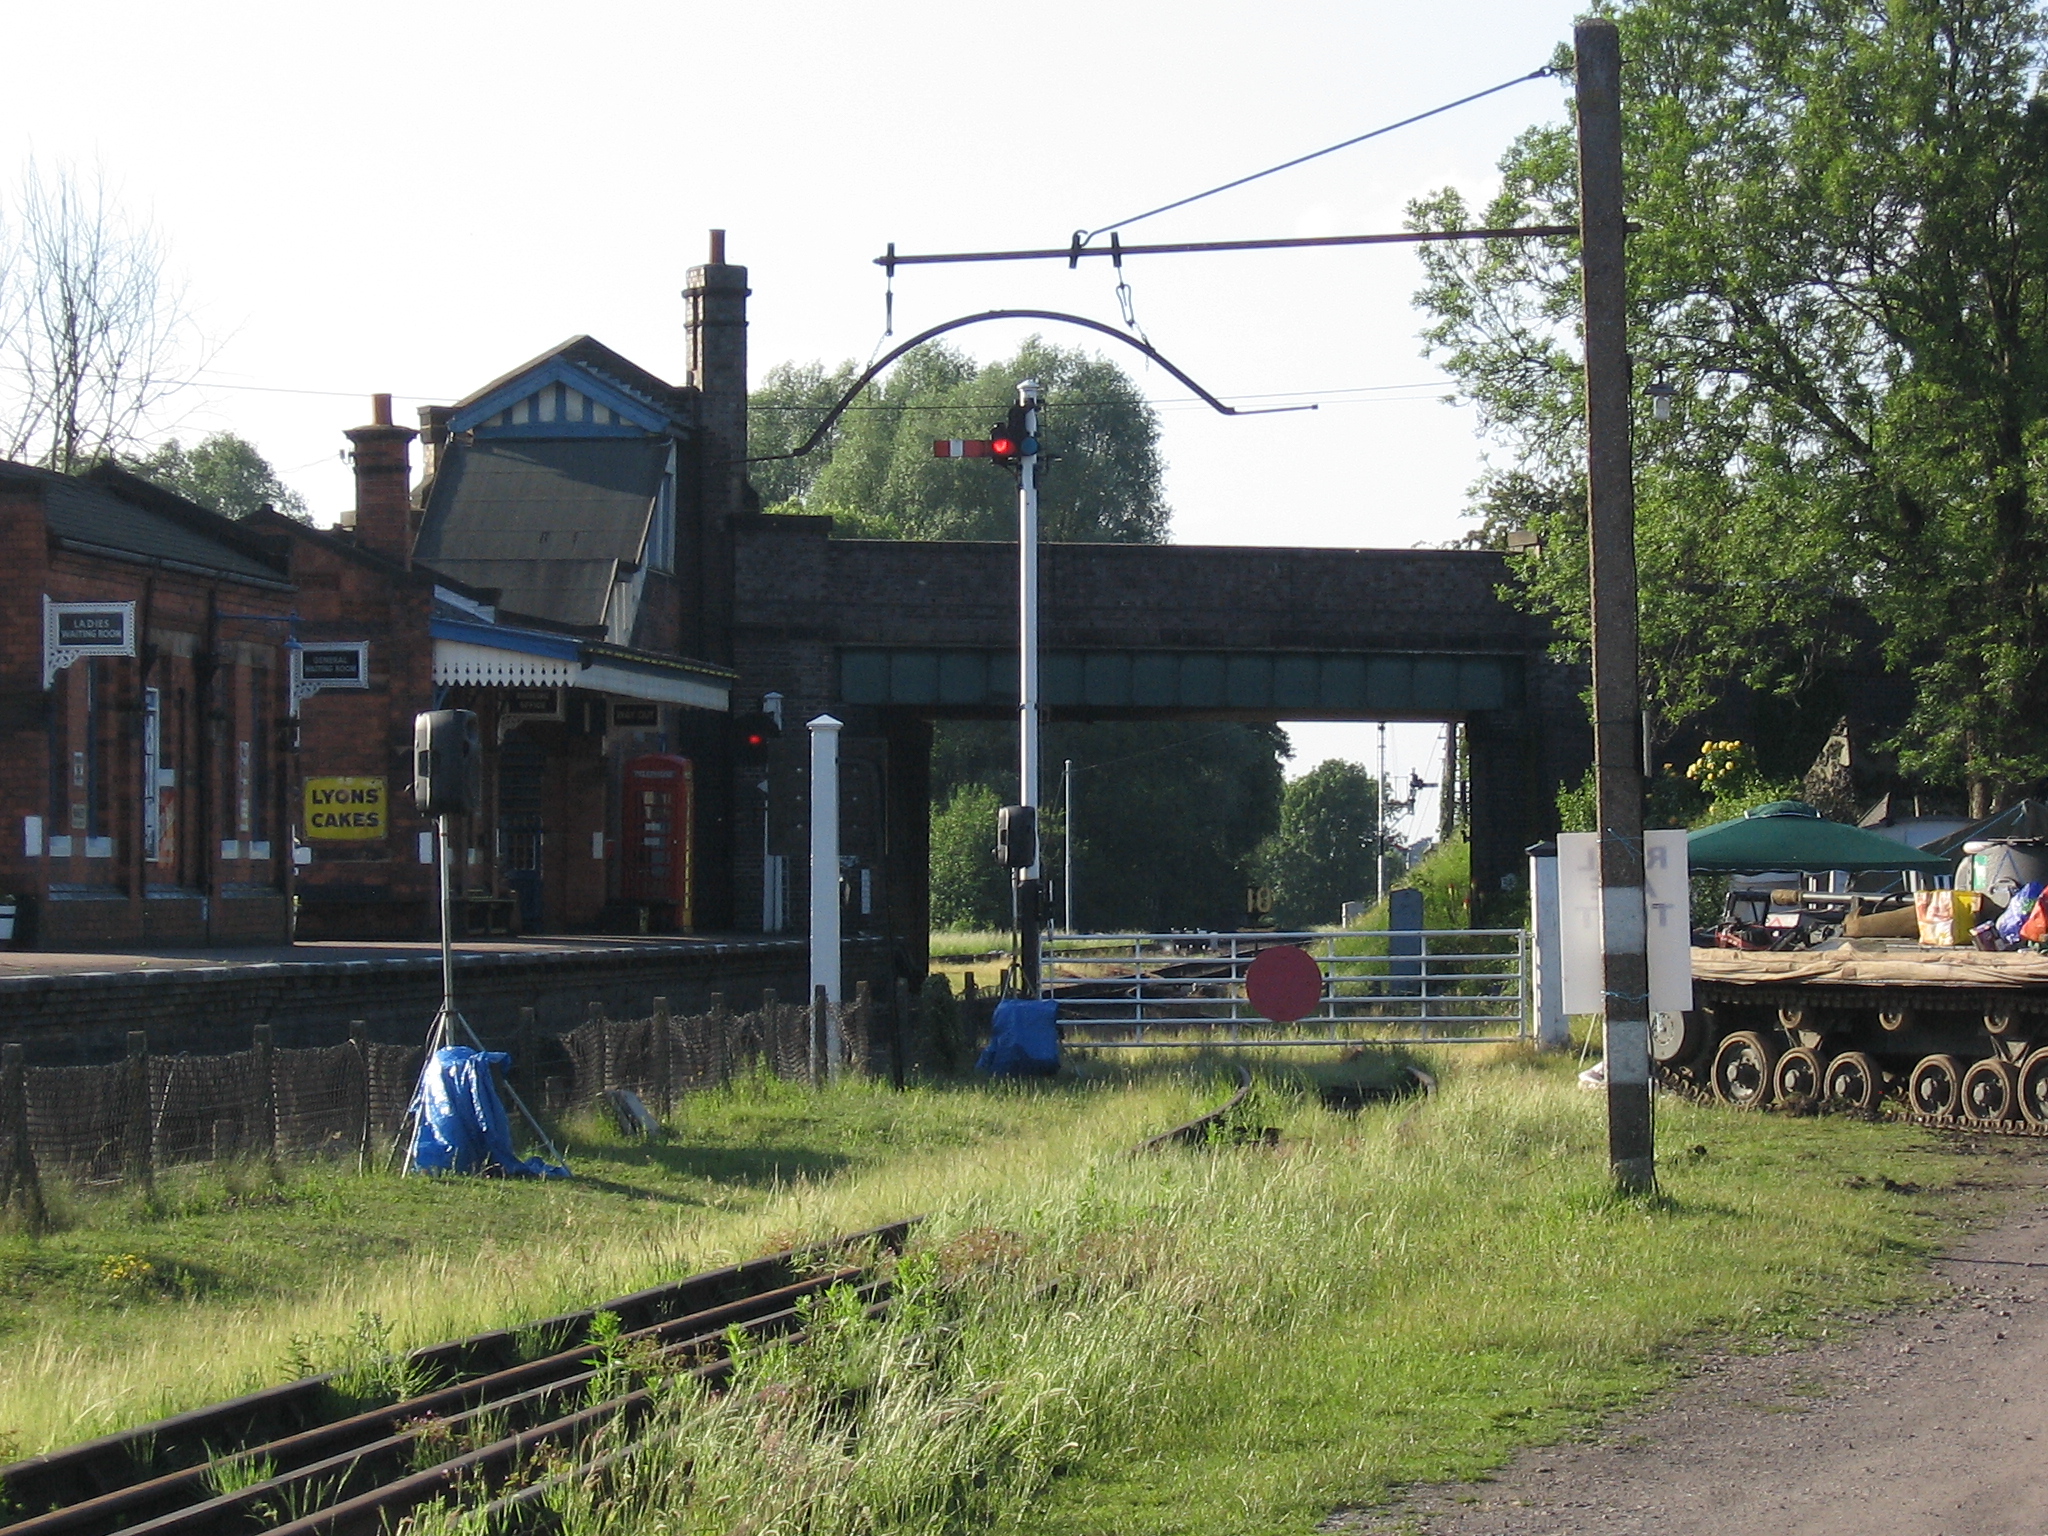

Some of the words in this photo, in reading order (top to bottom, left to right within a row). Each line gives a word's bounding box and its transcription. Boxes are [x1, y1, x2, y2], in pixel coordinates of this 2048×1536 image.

[73, 618, 110, 629] LADIES
[61, 629, 97, 639] WAITING
[98, 629, 122, 639] ROOM
[311, 812, 380, 828] CAKES
